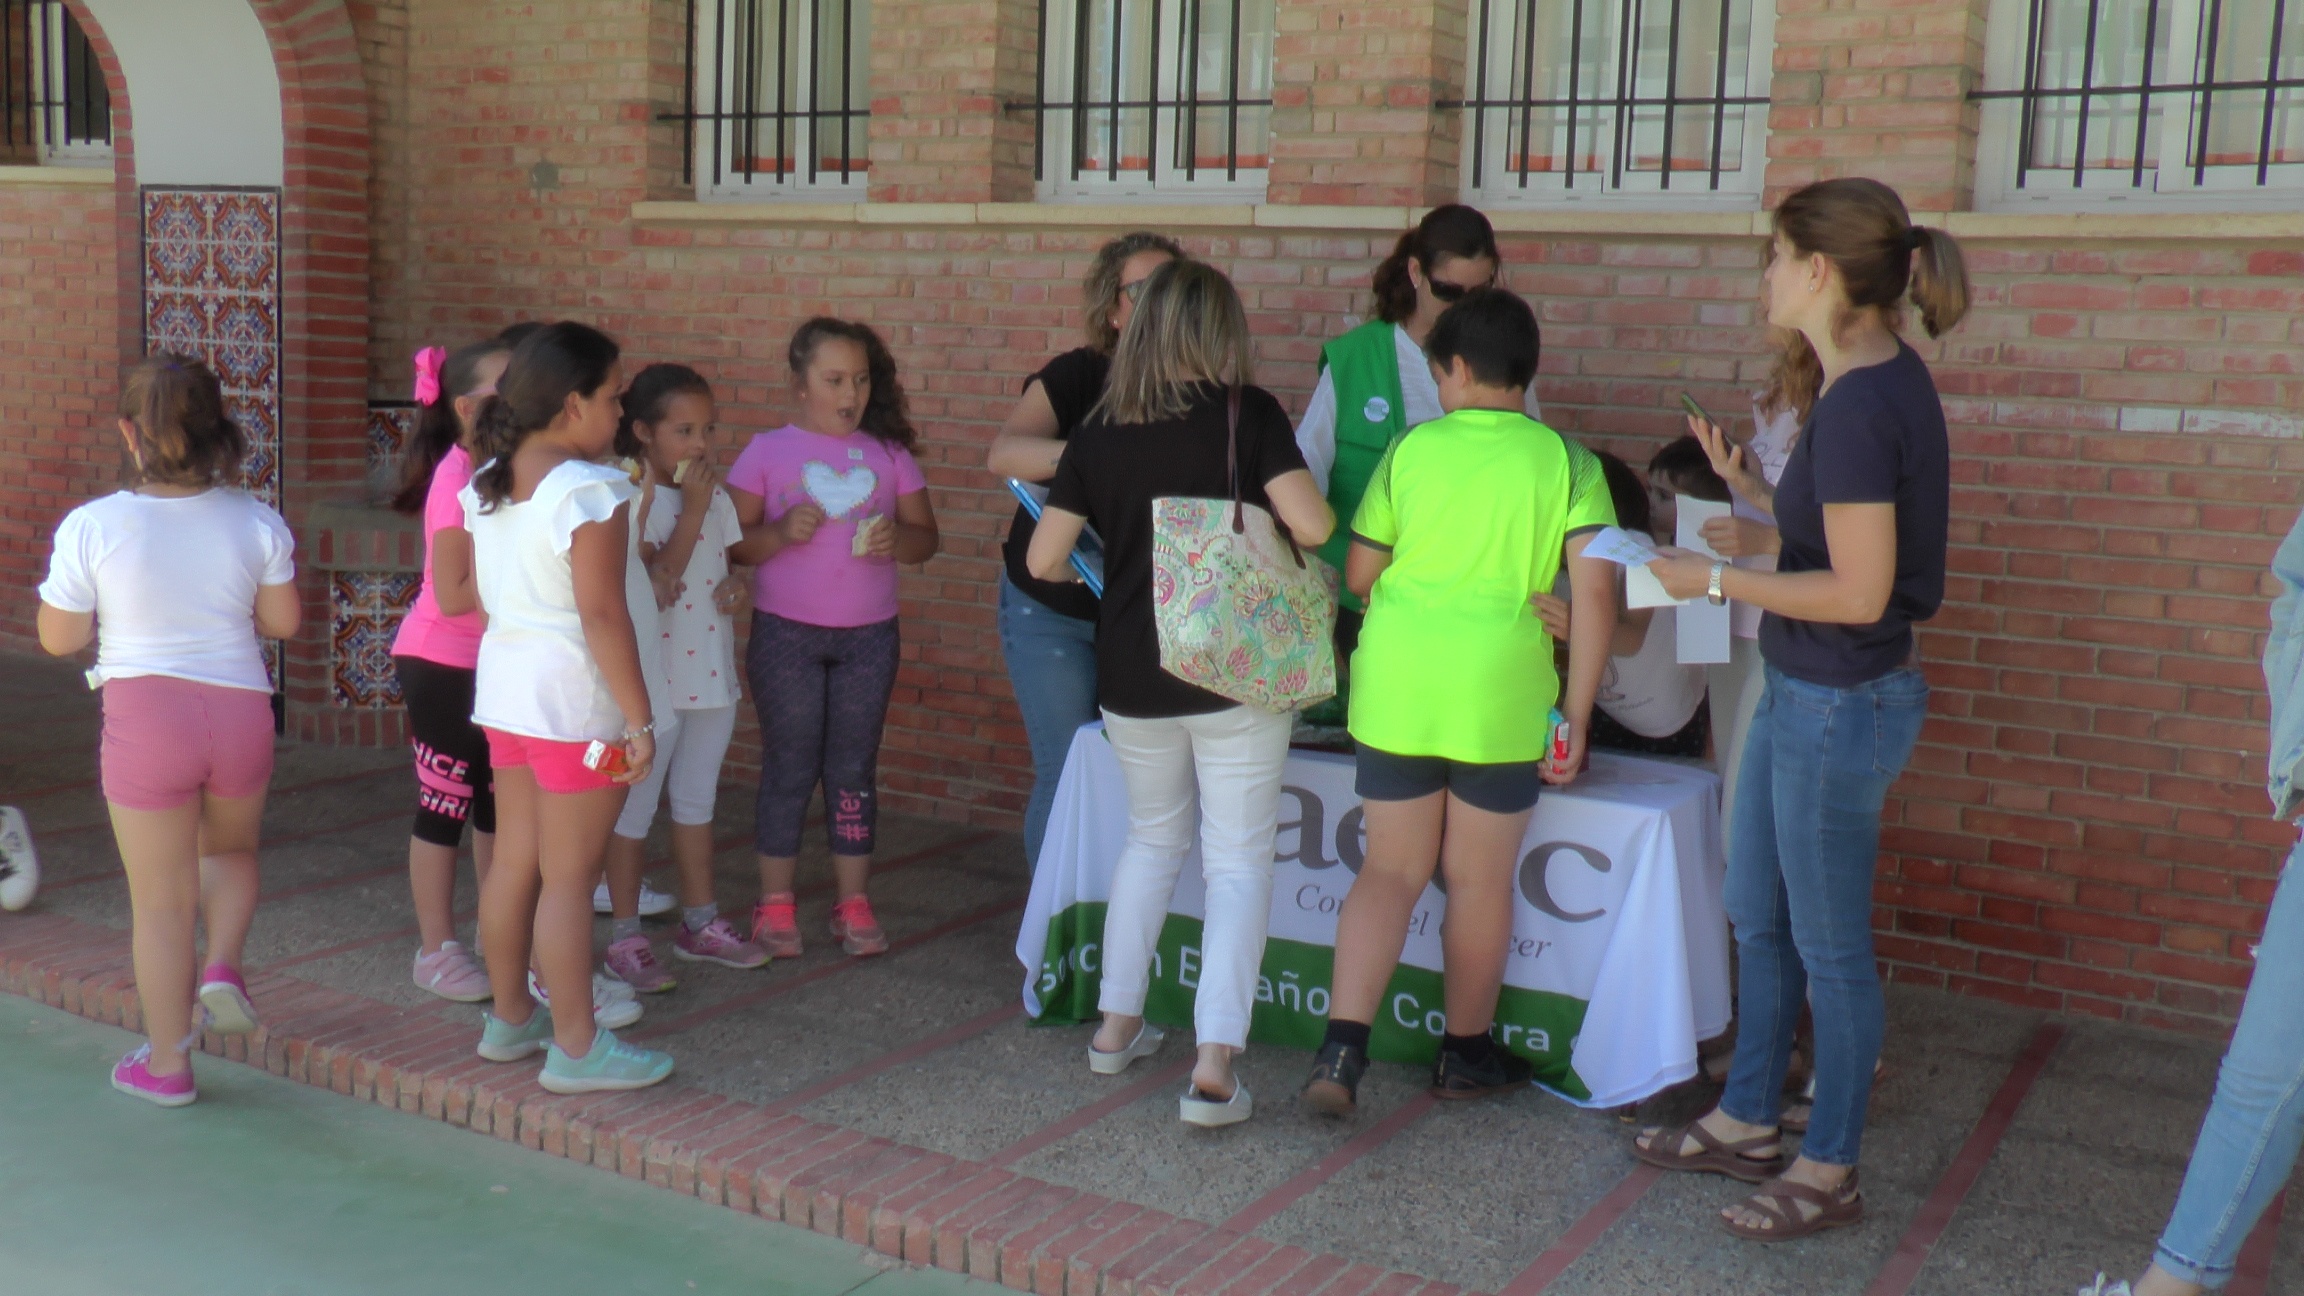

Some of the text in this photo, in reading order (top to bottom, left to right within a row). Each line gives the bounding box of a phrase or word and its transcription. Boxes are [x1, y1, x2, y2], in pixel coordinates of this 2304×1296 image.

[412, 737, 469, 782] NICE
[420, 785, 469, 820] GIRL
[1393, 992, 1550, 1052] Cotra
